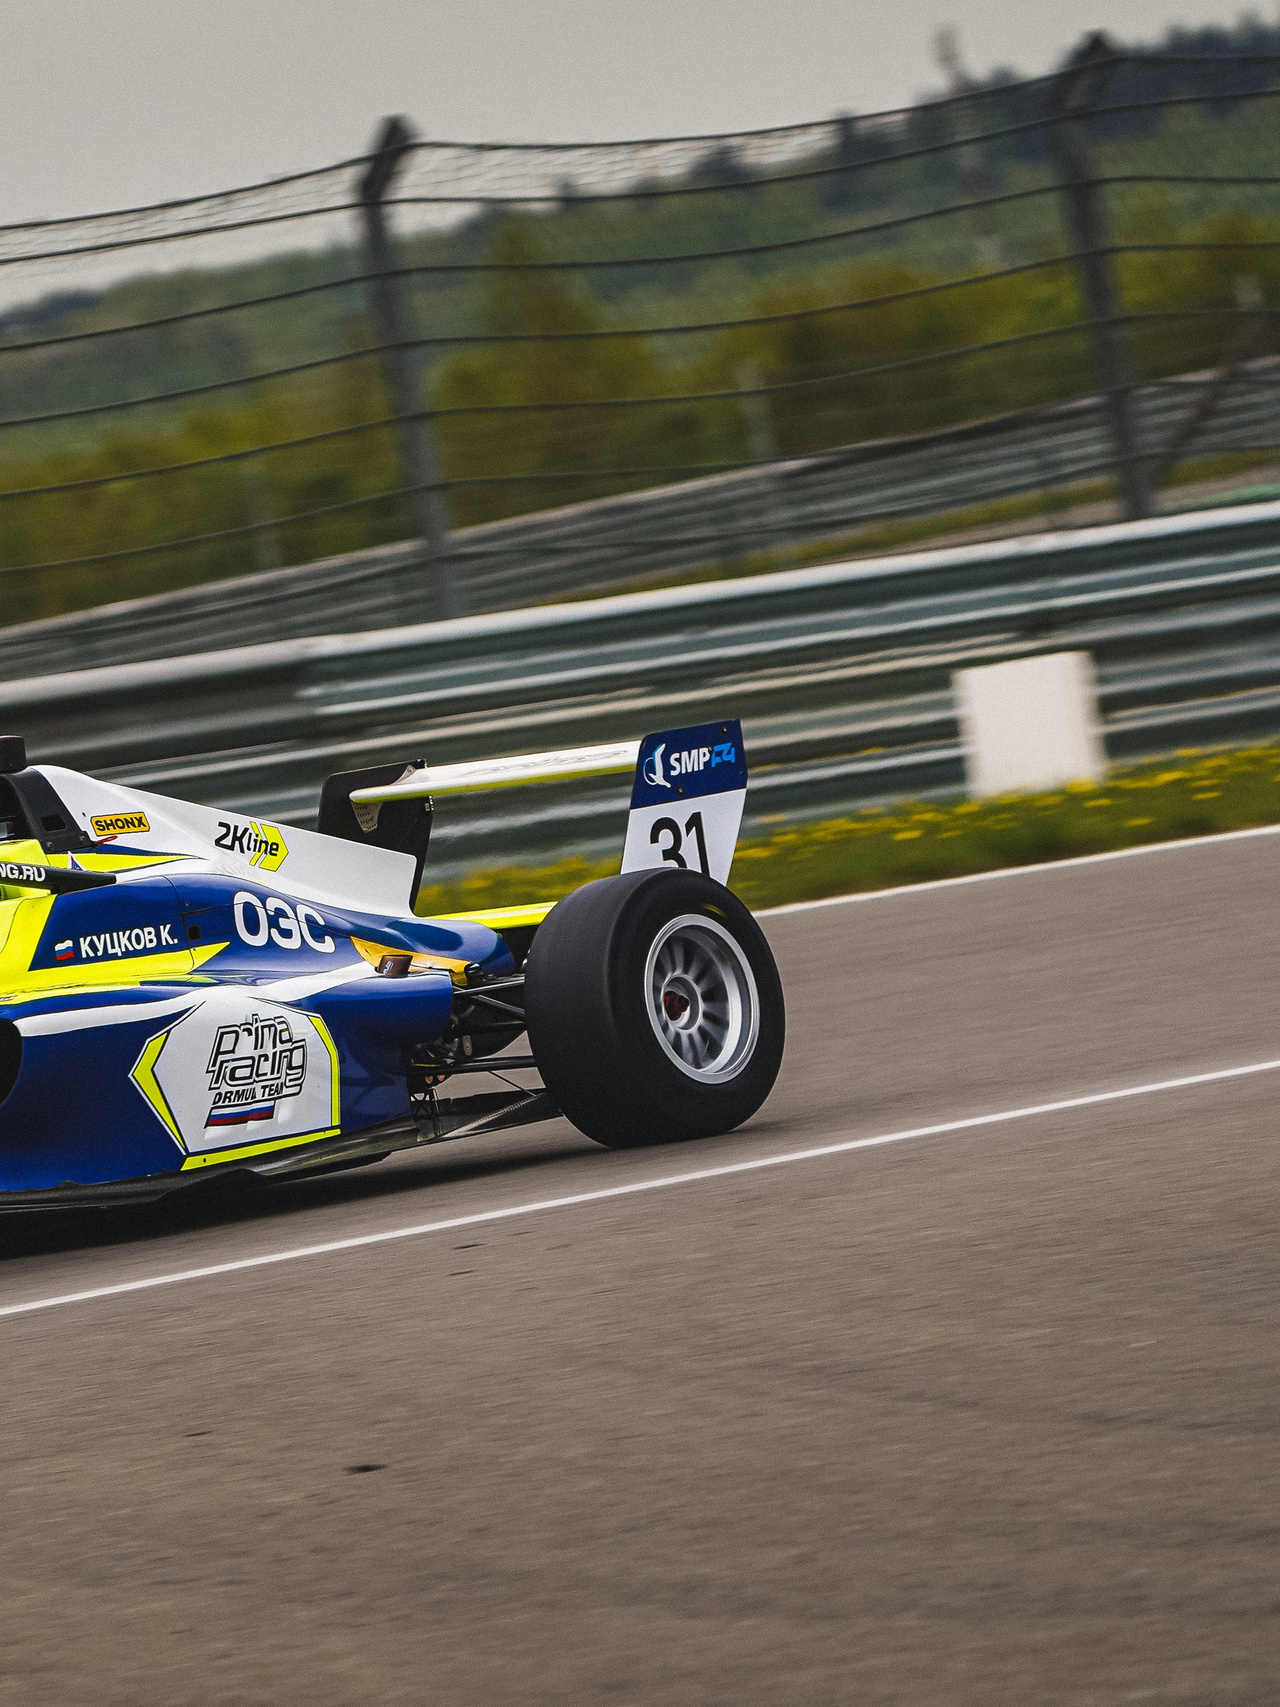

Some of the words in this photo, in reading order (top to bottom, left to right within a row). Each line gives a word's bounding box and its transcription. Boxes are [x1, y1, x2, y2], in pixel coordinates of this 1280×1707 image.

[670, 747, 711, 776] SMP
[94, 816, 148, 831] SHONX
[214, 821, 280, 857] 2Kline
[650, 811, 710, 878] 31
[79, 926, 158, 959] КУЦКОВ
